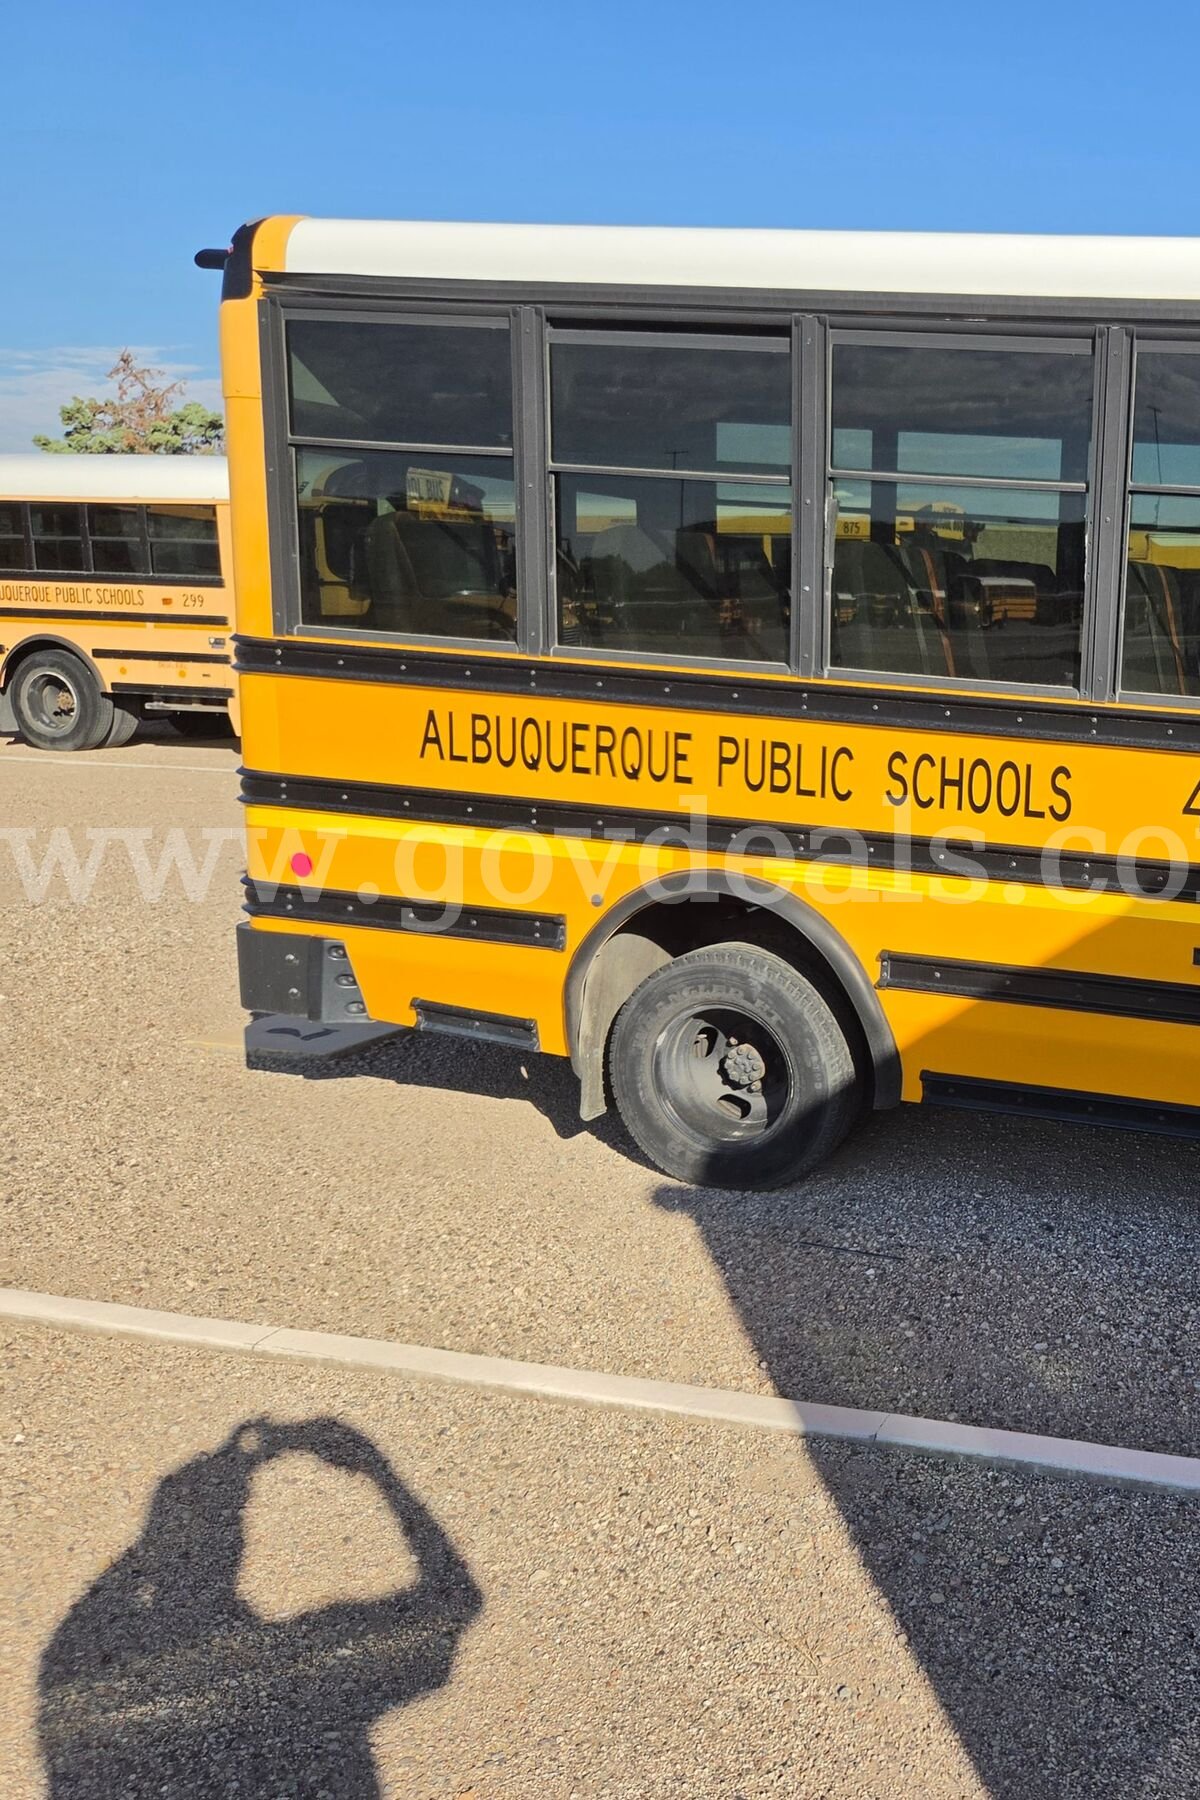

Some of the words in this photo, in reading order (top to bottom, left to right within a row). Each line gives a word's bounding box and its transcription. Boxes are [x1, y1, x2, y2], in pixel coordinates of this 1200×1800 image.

[843, 521, 860, 534] 875
[55, 586, 93, 605] PUBLIC
[96, 589, 145, 606] SCHOOLS
[182, 593, 204, 607] 299
[420, 709, 693, 785] ALBUQUERQUE
[718, 735, 855, 802] PUBLIC
[886, 750, 1072, 822] SCHOOLS
